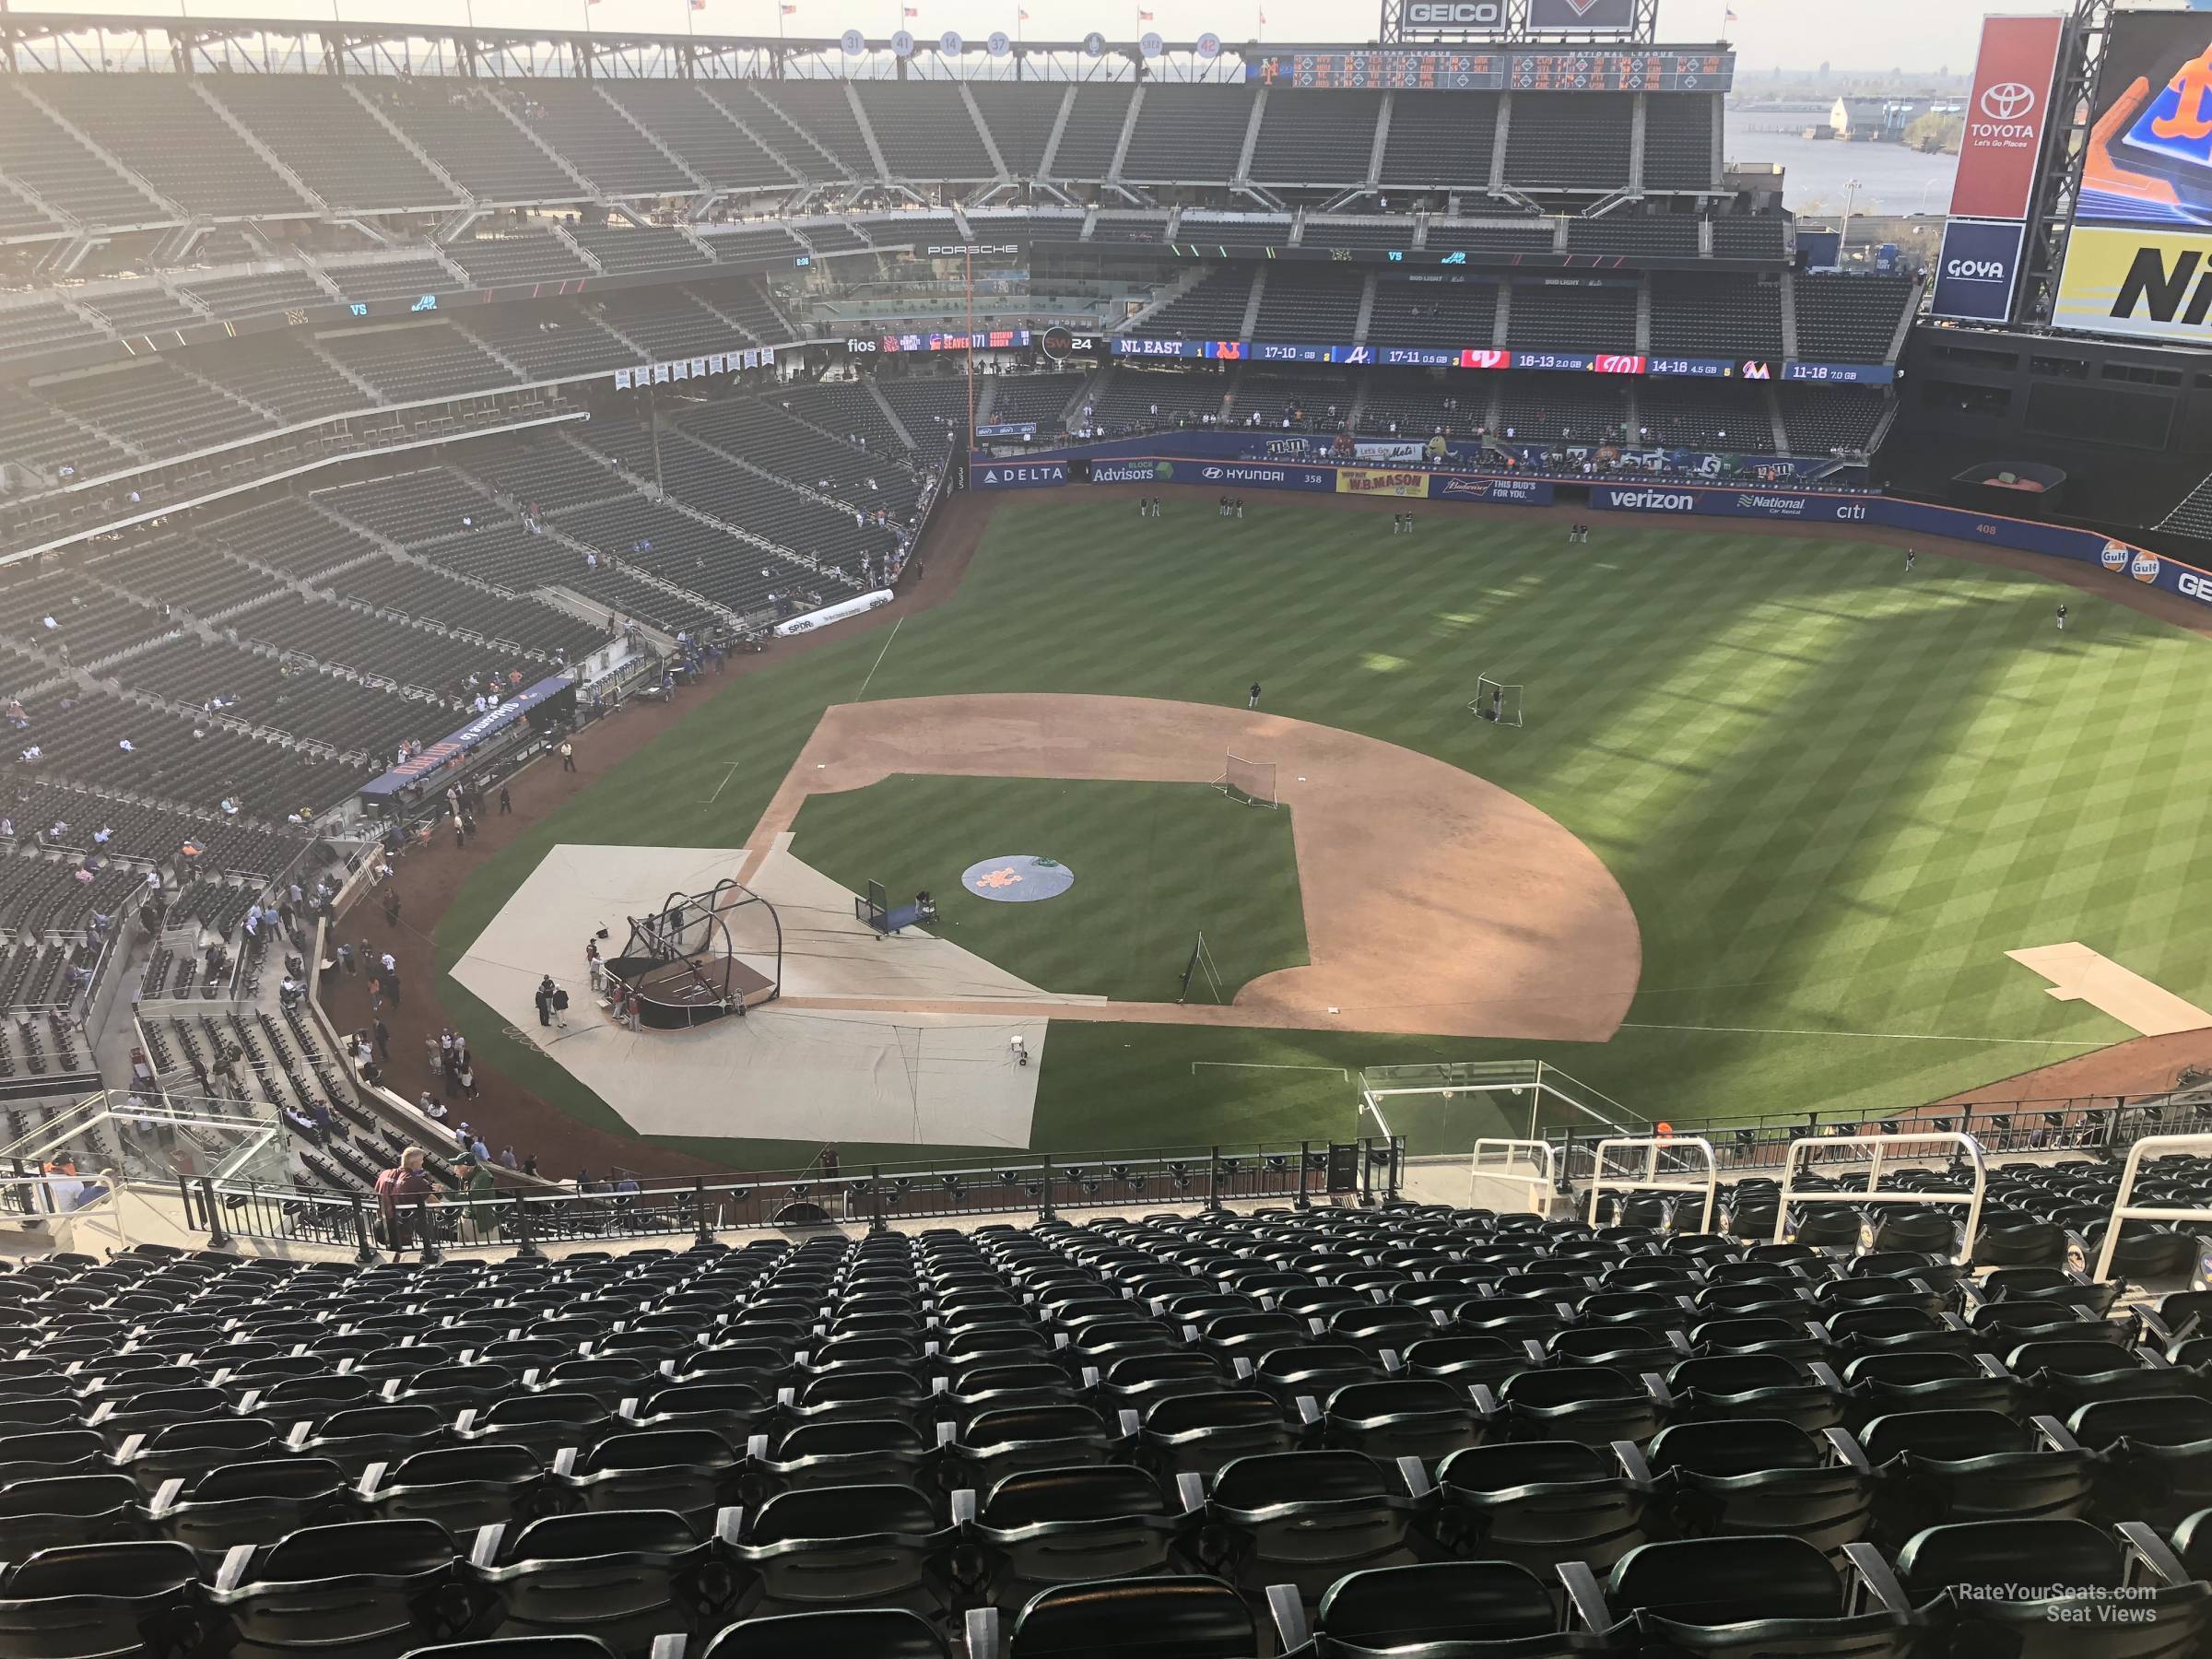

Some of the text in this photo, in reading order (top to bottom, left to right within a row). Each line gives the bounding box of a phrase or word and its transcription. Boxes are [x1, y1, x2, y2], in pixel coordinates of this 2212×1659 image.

[1410, 4, 1497, 22] GEICO
[847, 36, 858, 49] 31
[896, 37, 908, 50] 41
[946, 38, 956, 51] 14
[992, 39, 1006, 51] 37
[1201, 40, 1215, 52] 42
[1971, 124, 2034, 138] TOYOTA
[1974, 139, 2027, 147] Let's Go Places
[927, 244, 1018, 255] PORSCHE
[1947, 259, 2004, 278] GOYA
[848, 339, 877, 353] fios
[971, 335, 985, 348] 171
[1071, 338, 1092, 349] 24
[1121, 340, 1182, 355] NL EAST
[1197, 348, 1202, 358] 1
[1265, 347, 1296, 359] 17-10
[1304, 351, 1315, 359] GB
[1324, 353, 1330, 362] 2
[1389, 350, 1420, 363] 17-11
[1422, 355, 1435, 363] 0.5
[1452, 357, 1460, 366] 3
[1556, 360, 1569, 369] 2.0
[1570, 360, 1583, 369] GB
[1585, 361, 1594, 371] 4
[1690, 365, 1704, 374] 4.5
[1704, 366, 1717, 374] GB
[1793, 366, 1857, 381] 11-18 7.0 GB
[1004, 467, 1064, 482] DELTA
[1093, 468, 1154, 482] Advisors
[1226, 468, 1285, 482] HYUNDAI
[1304, 474, 1322, 485] 358
[1494, 479, 1536, 490] THIS BUD'S
[1493, 488, 1527, 499] FOR YOU.
[1610, 488, 1693, 510] verizon
[1753, 495, 1804, 510] National
[1976, 524, 1996, 535] 408
[2102, 550, 2126, 563] Gulf
[2132, 561, 2158, 573] Gulf
[469, 701, 520, 734] Welcome
